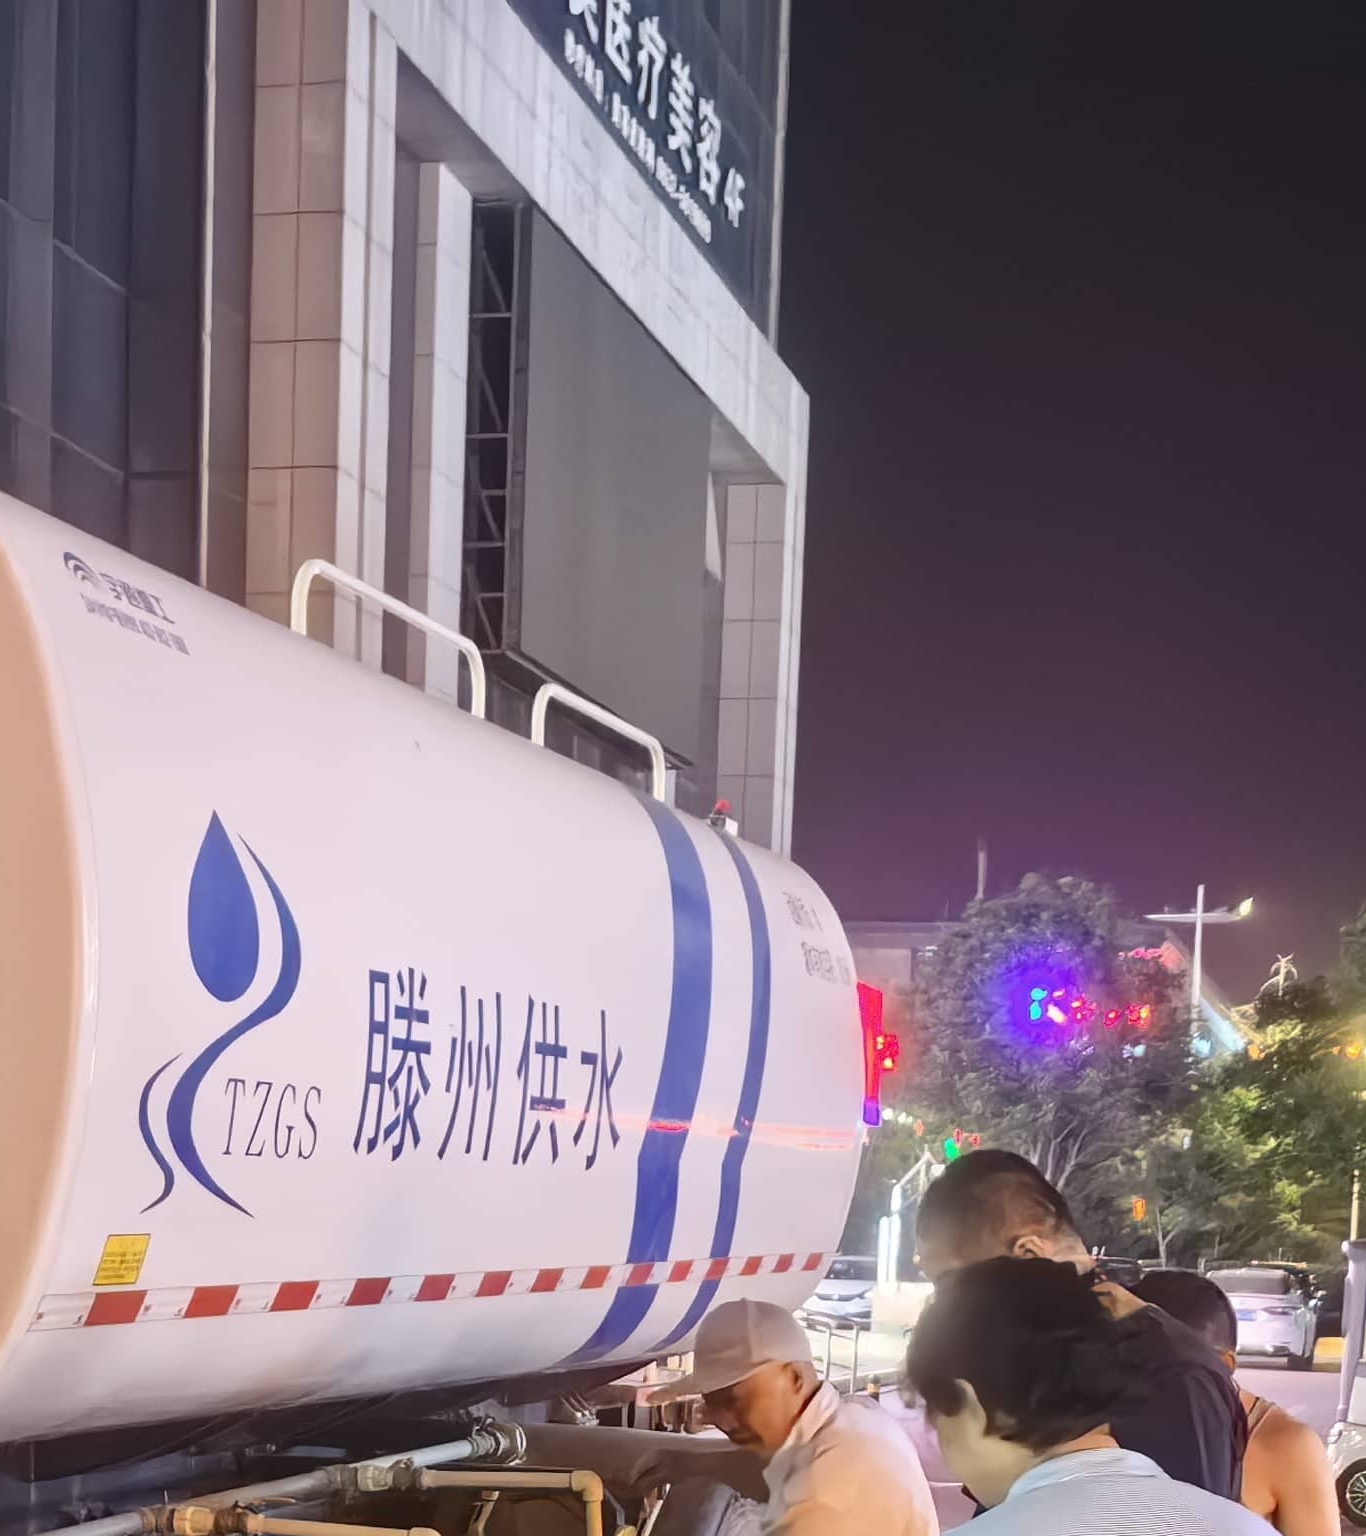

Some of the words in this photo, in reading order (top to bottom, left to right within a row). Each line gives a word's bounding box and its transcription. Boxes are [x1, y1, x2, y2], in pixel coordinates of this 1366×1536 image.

[221, 1077, 322, 1159] TZGS
[352, 966, 623, 1171] 滕州供水
